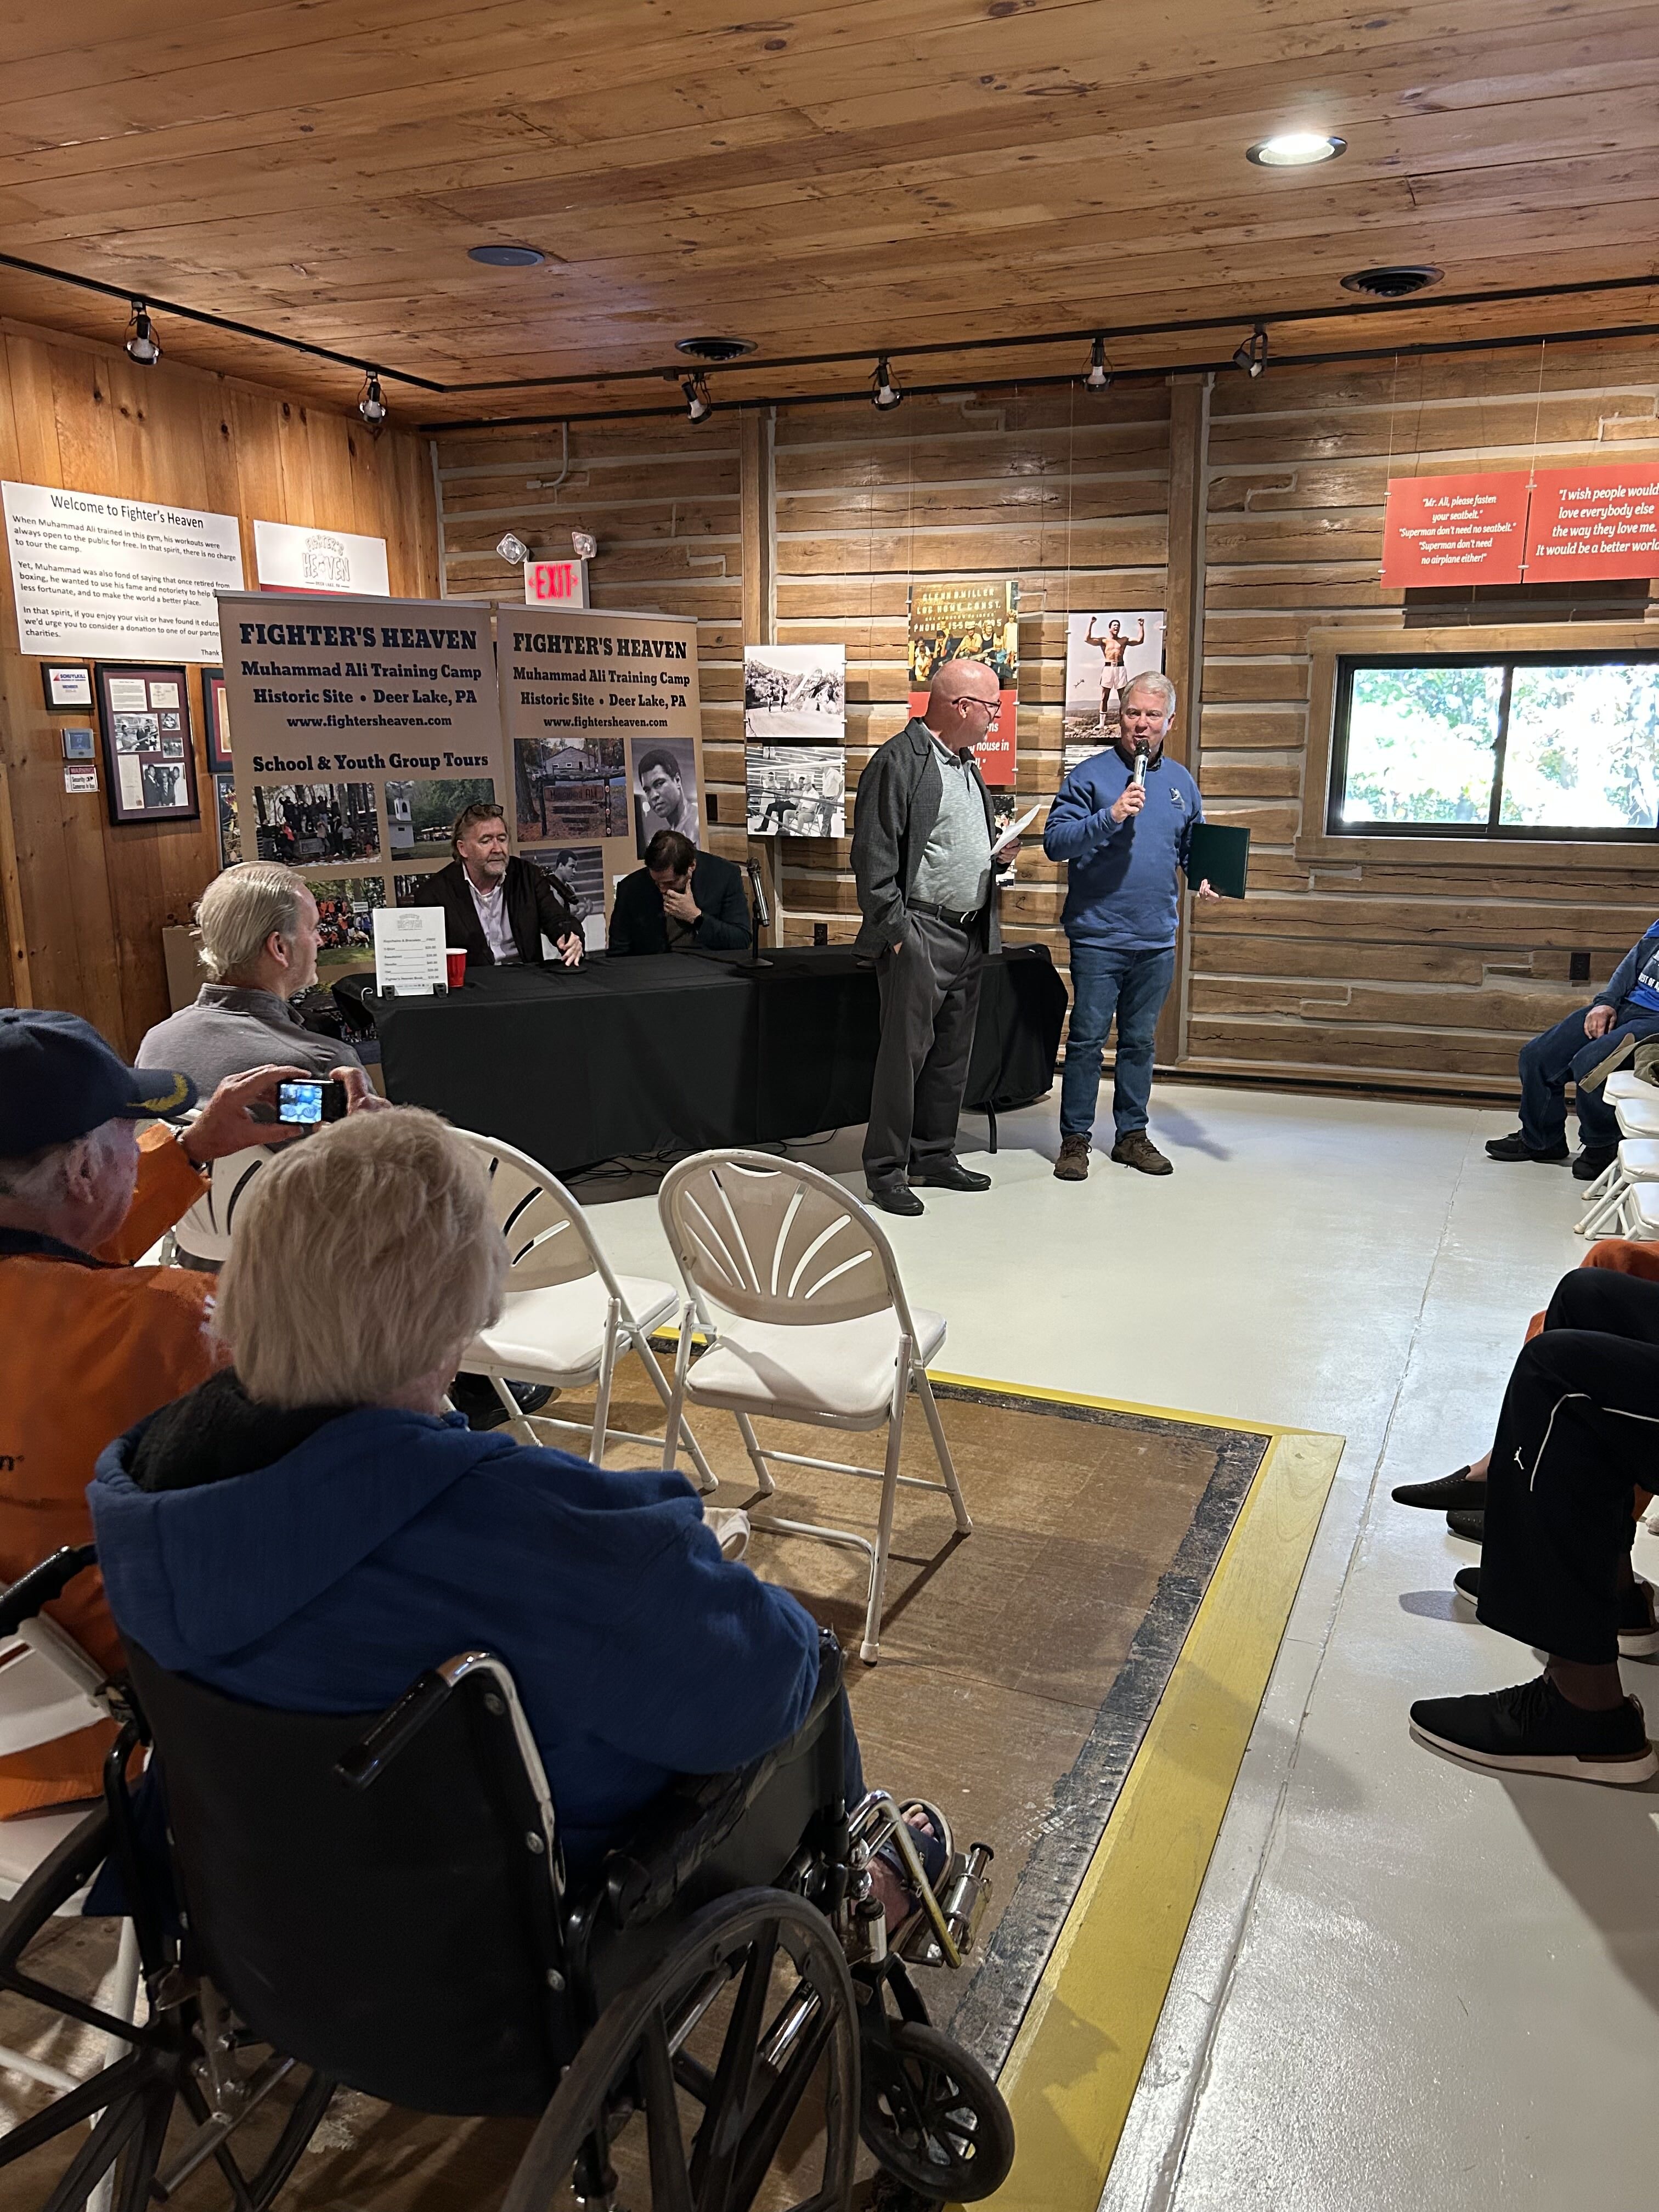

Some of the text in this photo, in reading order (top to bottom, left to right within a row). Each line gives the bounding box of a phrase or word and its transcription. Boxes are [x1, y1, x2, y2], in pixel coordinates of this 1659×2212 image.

[1423, 494, 1496, 508] "Mr. Ali, please fasten
[1559, 489, 1567, 500] "I
[1568, 487, 1591, 500] wish
[1592, 485, 1626, 502] people
[50, 494, 204, 529] Welcome to Fighter's Heaven
[1432, 510, 1483, 523] your seatbelt."
[1559, 503, 1655, 520] love everybody else
[13, 515, 36, 526] When
[38, 518, 84, 531] Muhammad
[98, 527, 122, 536] trained
[175, 537, 204, 547] workouts
[1399, 527, 1435, 539] "Superman
[1437, 526, 1454, 535] don't
[1455, 524, 1472, 534] need
[1483, 523, 1516, 533] seatbelt."
[1553, 522, 1657, 539] the way they love me.
[14, 527, 41, 537] always
[123, 540, 138, 549] free.
[163, 547, 182, 555] spirit,
[217, 553, 236, 562] charge
[59, 545, 82, 553] camp.
[1419, 538, 1493, 552] "Superman don't need
[1536, 545, 1544, 556] It
[1547, 543, 1577, 555] would
[1578, 542, 1590, 554] be
[1592, 544, 1598, 553] a
[1600, 541, 1630, 553] better
[1431, 554, 1460, 566] airplane
[1461, 553, 1487, 562] either!"
[18, 560, 33, 570] Yet,
[35, 563, 81, 574] Muhammad
[115, 571, 130, 579] fond
[140, 575, 161, 584] saying
[19, 572, 48, 583] boxing,
[61, 577, 89, 585] wanted
[126, 583, 143, 591] fame
[159, 587, 188, 596] notoriety
[198, 589, 211, 597] help
[535, 563, 572, 599] EXIT
[20, 583, 36, 591] less
[37, 585, 76, 596] fortunate,
[136, 594, 155, 602] world
[51, 609, 72, 617] spirit,
[96, 613, 116, 621] enjoy
[134, 614, 148, 622] visit
[26, 628, 61, 637] charities.
[126, 624, 156, 633] donation
[240, 623, 477, 650] FIGHTER'S HEAVEN
[513, 633, 687, 658] FIGHTER'S HEAVEN
[241, 661, 481, 681] Muhammad Ali Training Camp
[513, 667, 690, 687] Muhammad Ali Training Camp
[253, 689, 477, 706] Historic Site Deer Lake, PA
[521, 692, 686, 709] Historic Site Deer Lake, PA
[287, 714, 452, 729] www.fightersheaven.com
[544, 716, 668, 729] www.fightersheaven.com
[1001, 739, 1009, 751] in
[253, 752, 488, 772] School & Youth Group Tours
